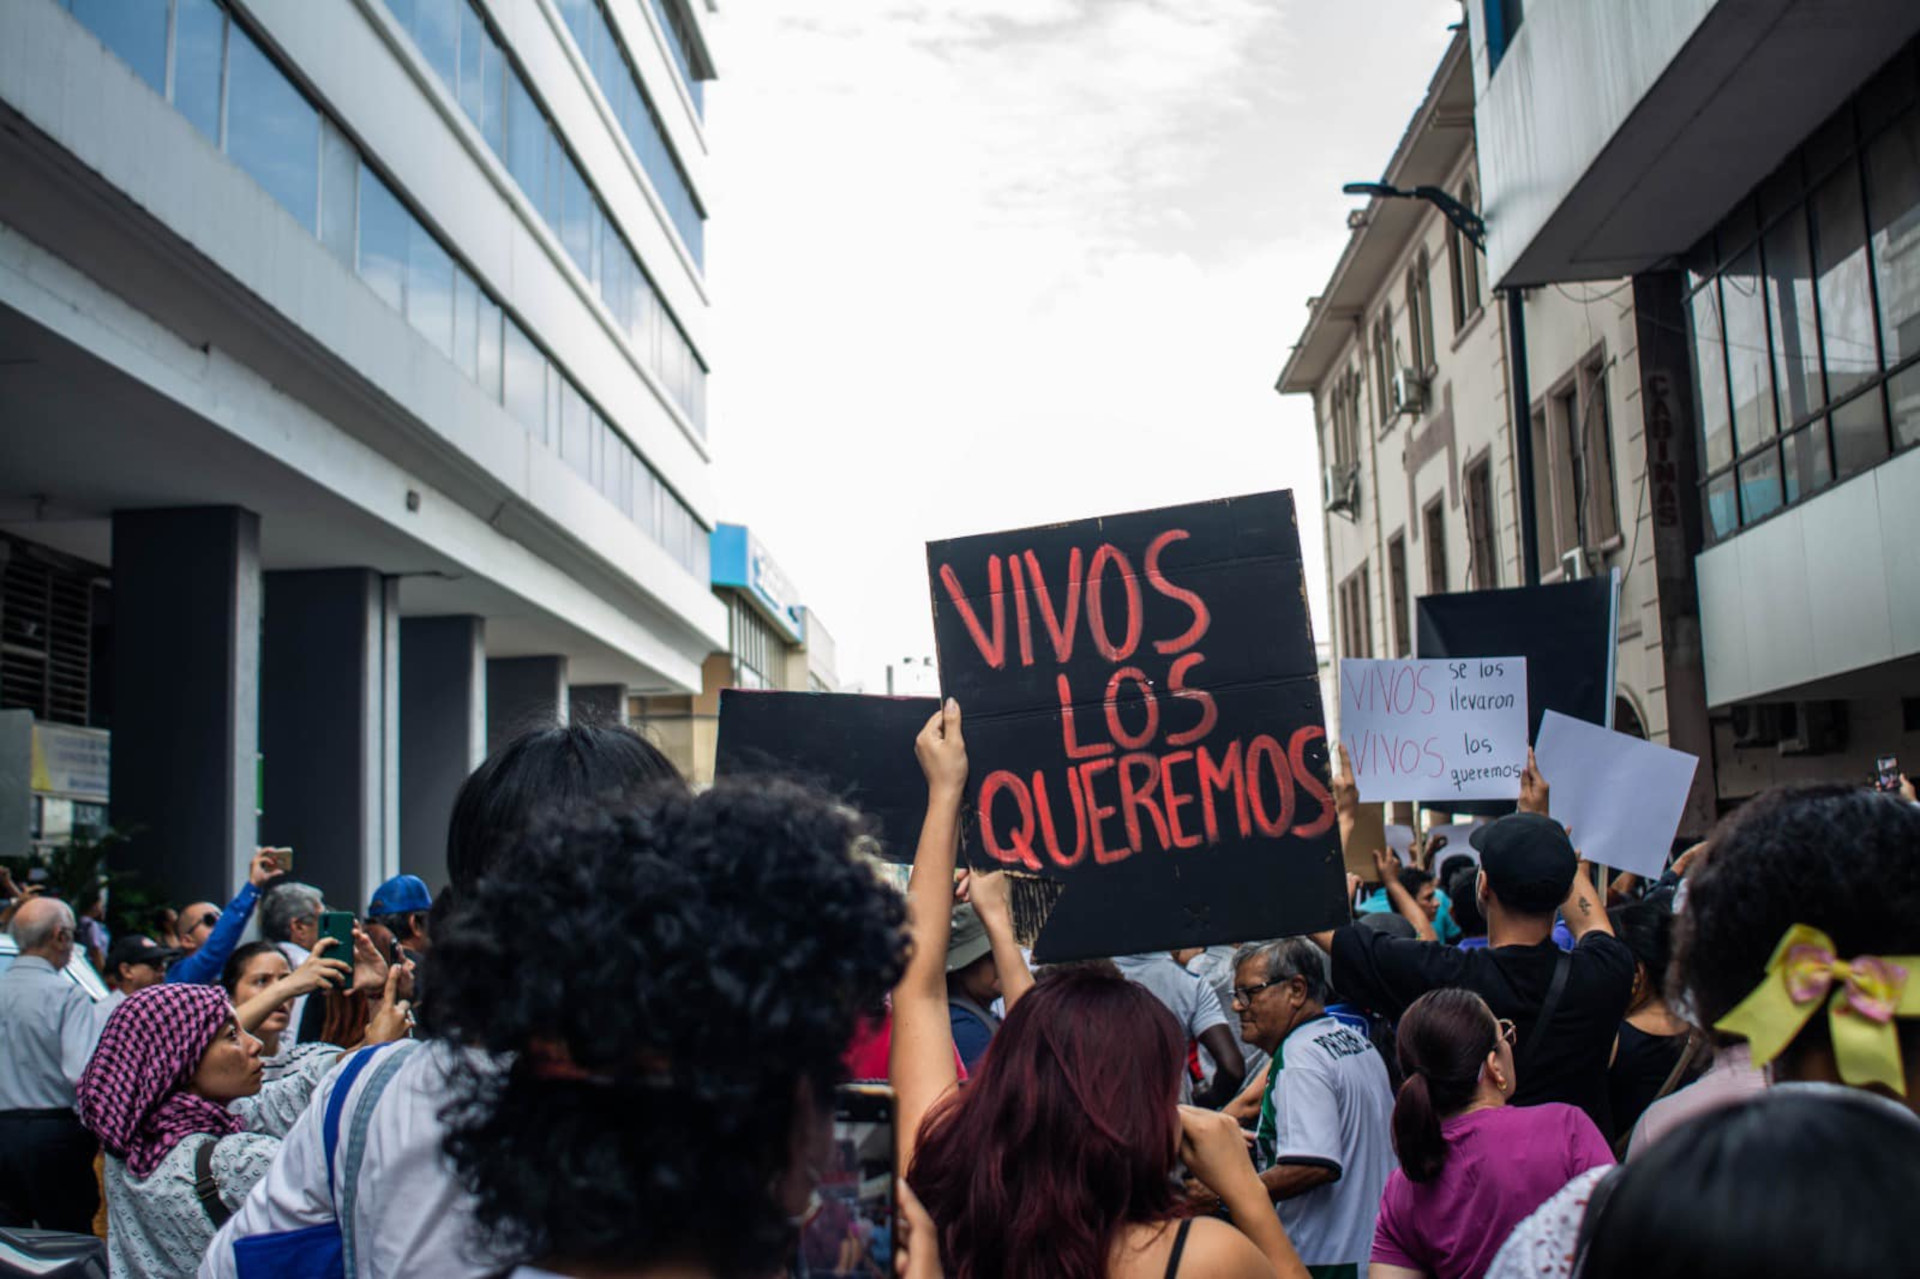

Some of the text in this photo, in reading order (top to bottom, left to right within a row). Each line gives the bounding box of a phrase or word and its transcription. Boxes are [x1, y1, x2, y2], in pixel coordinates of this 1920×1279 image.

[939, 529, 1211, 669] VIVOS
[1056, 652, 1218, 760] LOS
[1344, 665, 1435, 715] VIVOS
[1480, 662, 1504, 678] los
[1450, 687, 1515, 712] llevaron
[1351, 729, 1492, 778] VIVOS los
[1450, 764, 1522, 792] queremos
[977, 725, 1336, 871] QUEREMOS
